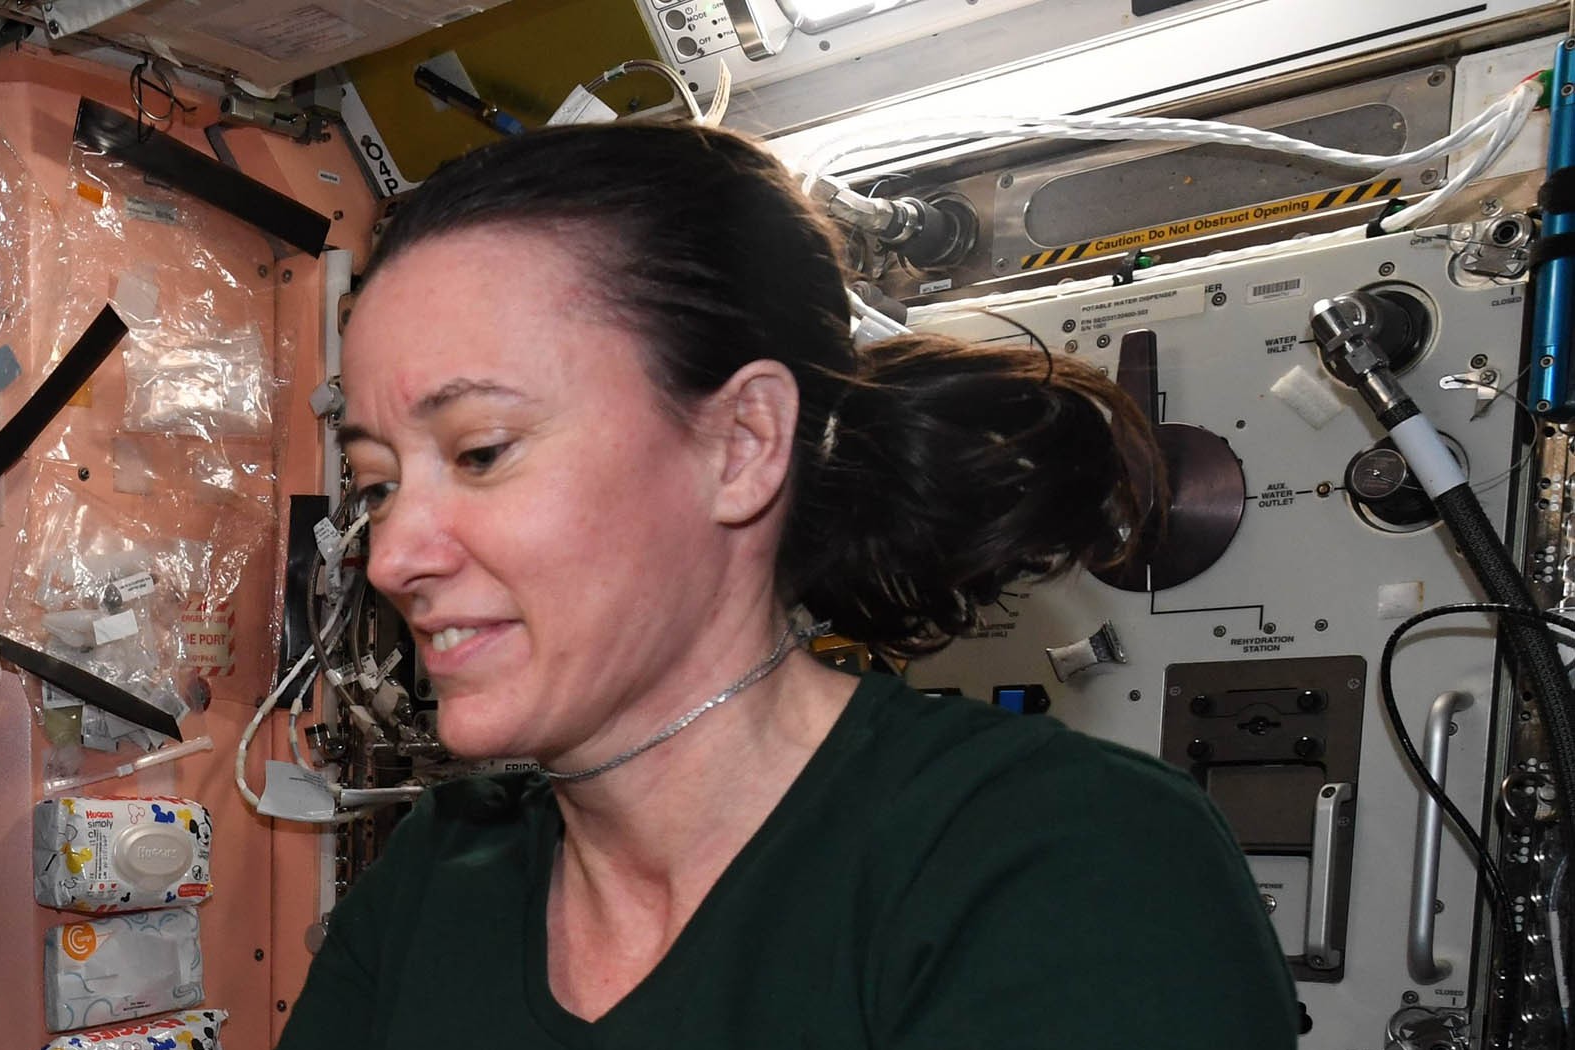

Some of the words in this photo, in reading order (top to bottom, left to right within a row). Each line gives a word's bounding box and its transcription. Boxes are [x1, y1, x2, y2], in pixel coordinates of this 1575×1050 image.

[699, 36, 711, 45] OFF
[1095, 232, 1145, 251] Caution:
[1148, 228, 1165, 241] Do
[1169, 222, 1190, 236] Not
[1194, 211, 1250, 231] Obstruct
[1253, 200, 1309, 219] Opening
[1082, 302, 1112, 312] POTABLE
[1114, 297, 1138, 306] WATER
[1139, 290, 1178, 302] DISPENSER
[1491, 296, 1522, 307] CLOSED
[1265, 335, 1297, 347] WATER
[1267, 344, 1294, 354] INLET
[1261, 490, 1293, 500] WATER
[1258, 498, 1294, 508] OUTLET
[199, 633, 226, 646] PORT
[1230, 634, 1294, 647] REHYDRATION
[1242, 644, 1280, 653] STATION
[87, 819, 114, 830] simply
